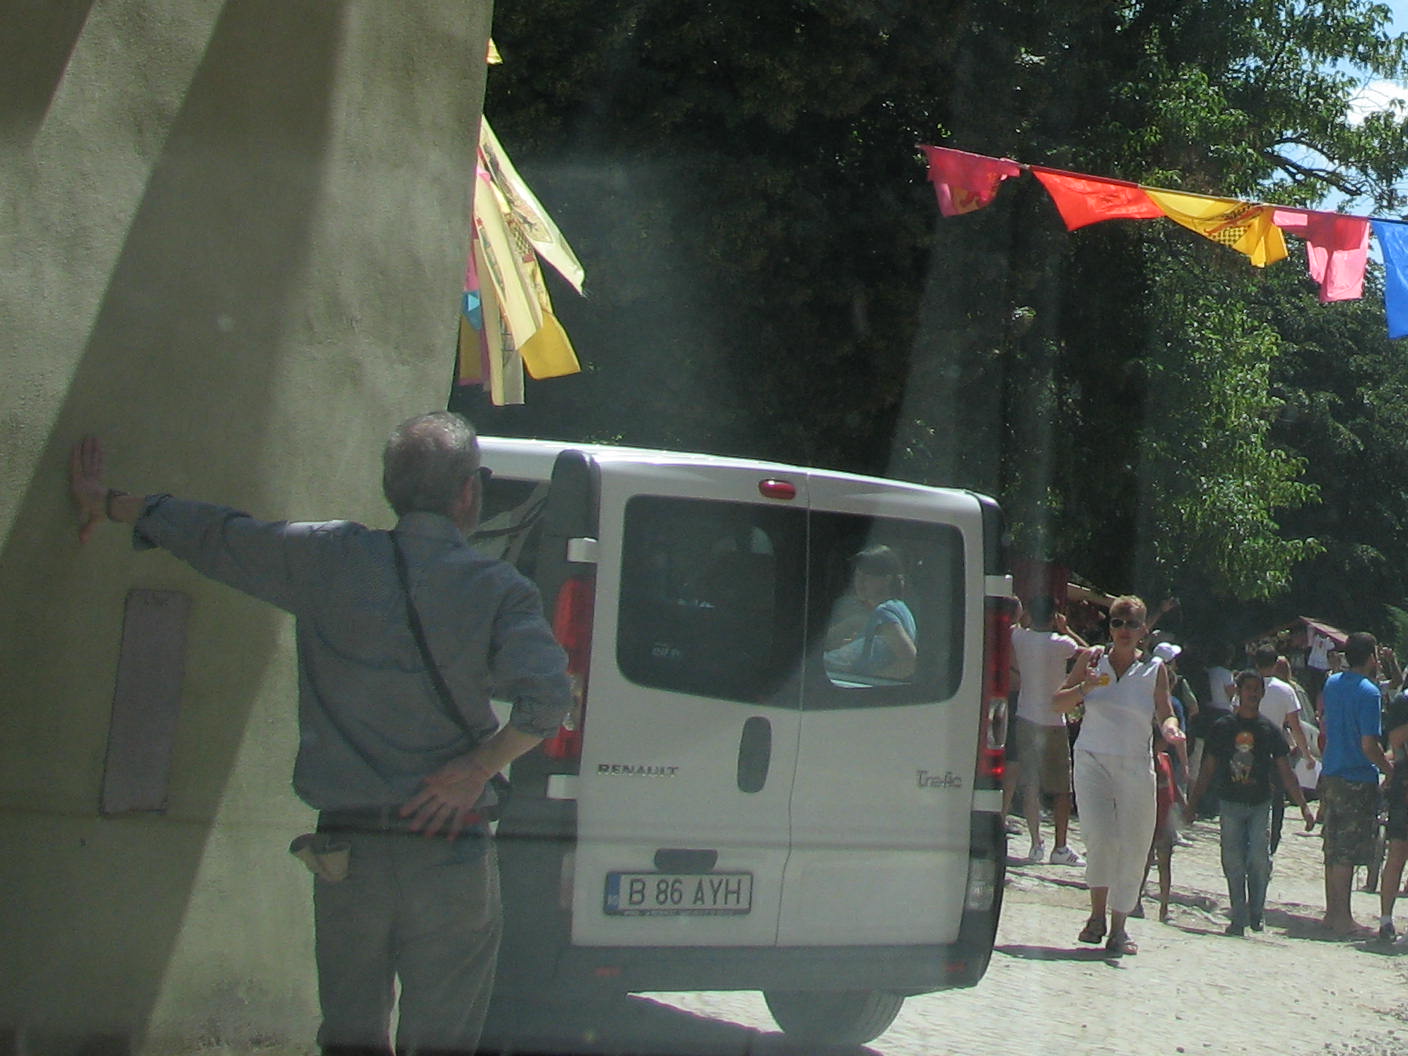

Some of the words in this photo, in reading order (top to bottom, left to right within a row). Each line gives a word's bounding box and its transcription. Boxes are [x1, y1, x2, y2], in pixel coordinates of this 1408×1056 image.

[596, 763, 681, 778] RENAULT
[628, 877, 646, 906] B
[655, 877, 684, 906] 86
[692, 877, 743, 906] AYH
